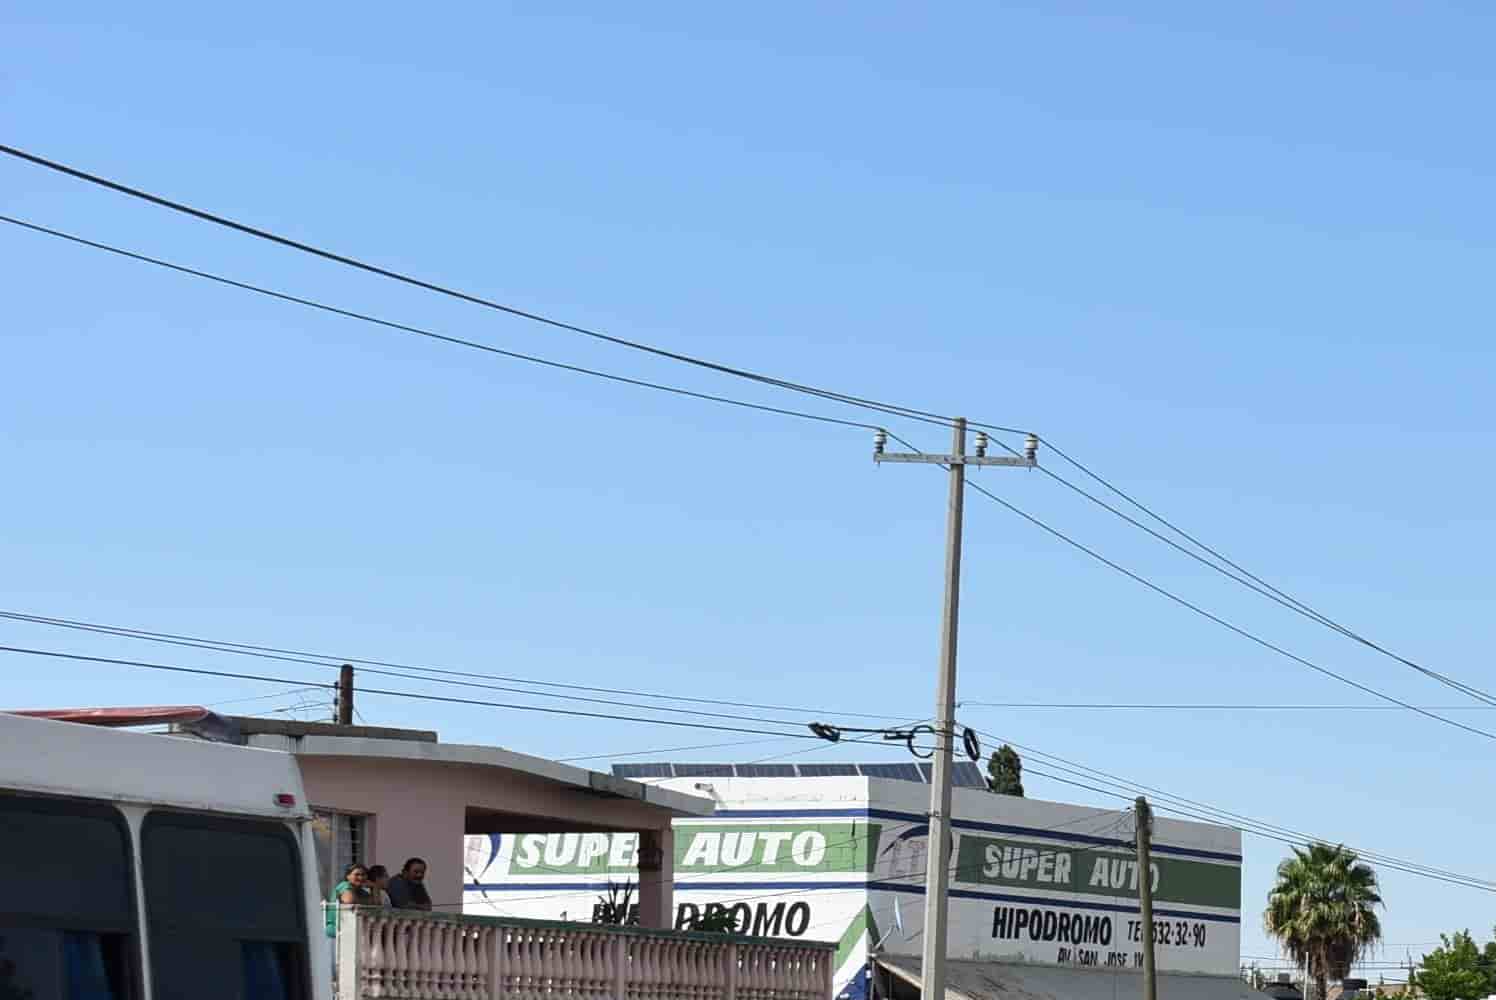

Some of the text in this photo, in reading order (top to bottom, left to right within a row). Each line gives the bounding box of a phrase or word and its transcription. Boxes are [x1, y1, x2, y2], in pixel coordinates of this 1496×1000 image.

[516, 830, 825, 868] SUPE AUTO
[983, 844, 1072, 884] SUPER
[991, 906, 1112, 946] HIPODROMO
